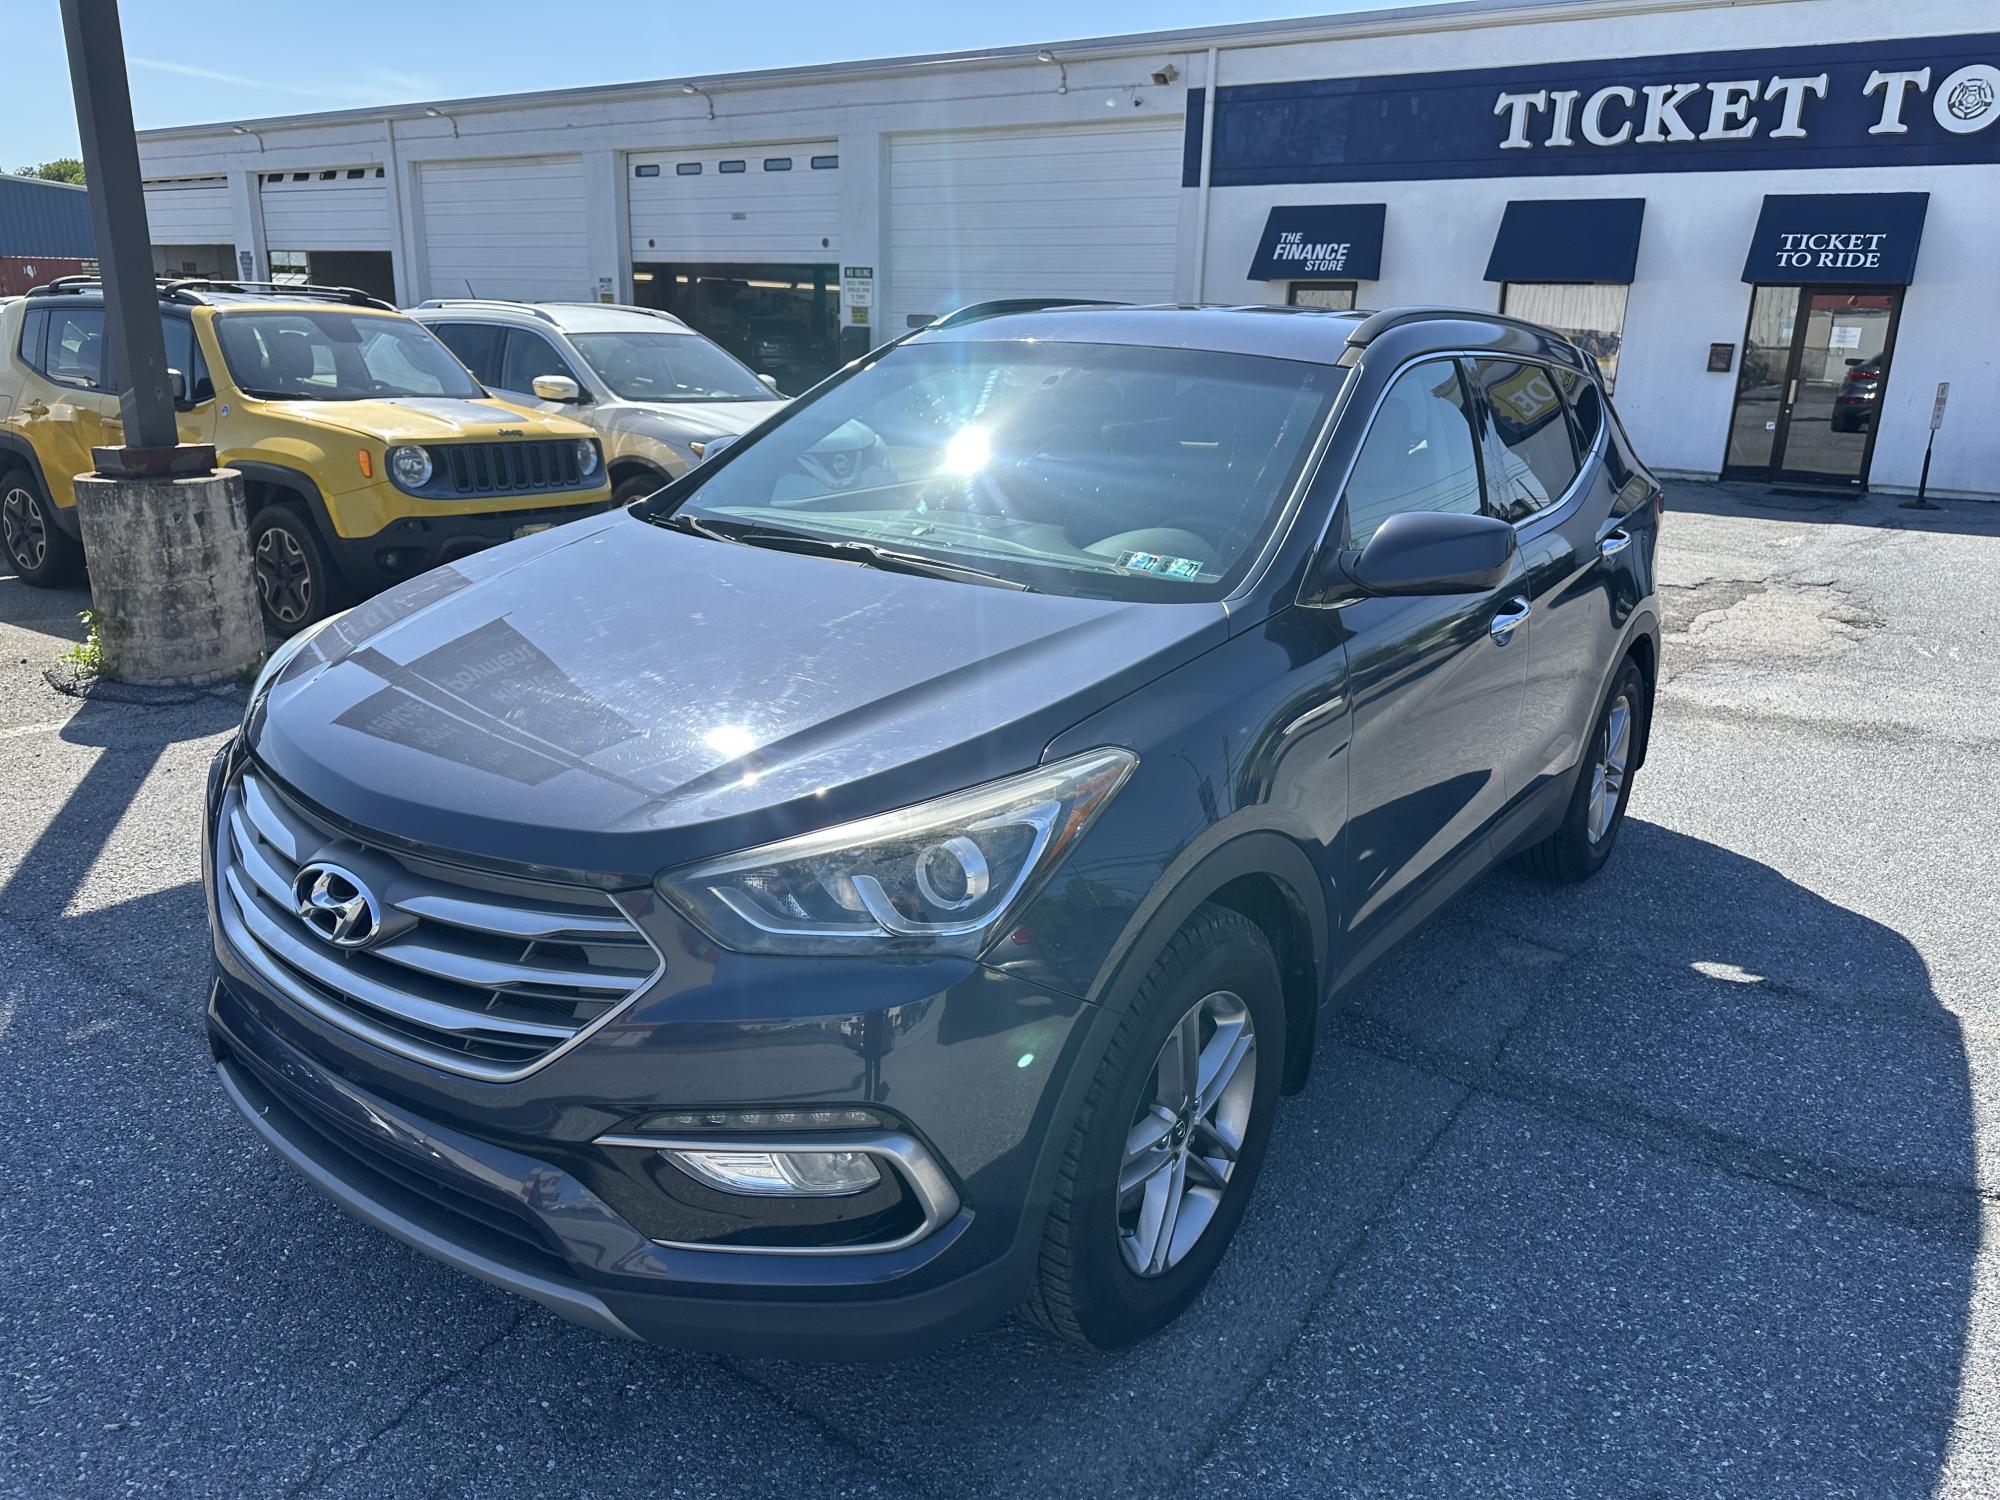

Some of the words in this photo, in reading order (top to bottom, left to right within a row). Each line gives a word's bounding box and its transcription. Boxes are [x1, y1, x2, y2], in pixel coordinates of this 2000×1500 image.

[1494, 72, 1829, 150] TICKET
[1280, 232, 1303, 243] THE
[1780, 233, 1887, 250] TICKET
[1272, 243, 1351, 260] FINANCE
[1776, 251, 1812, 267] TO
[1816, 252, 1881, 268] RIDE
[1304, 260, 1345, 271] STORE
